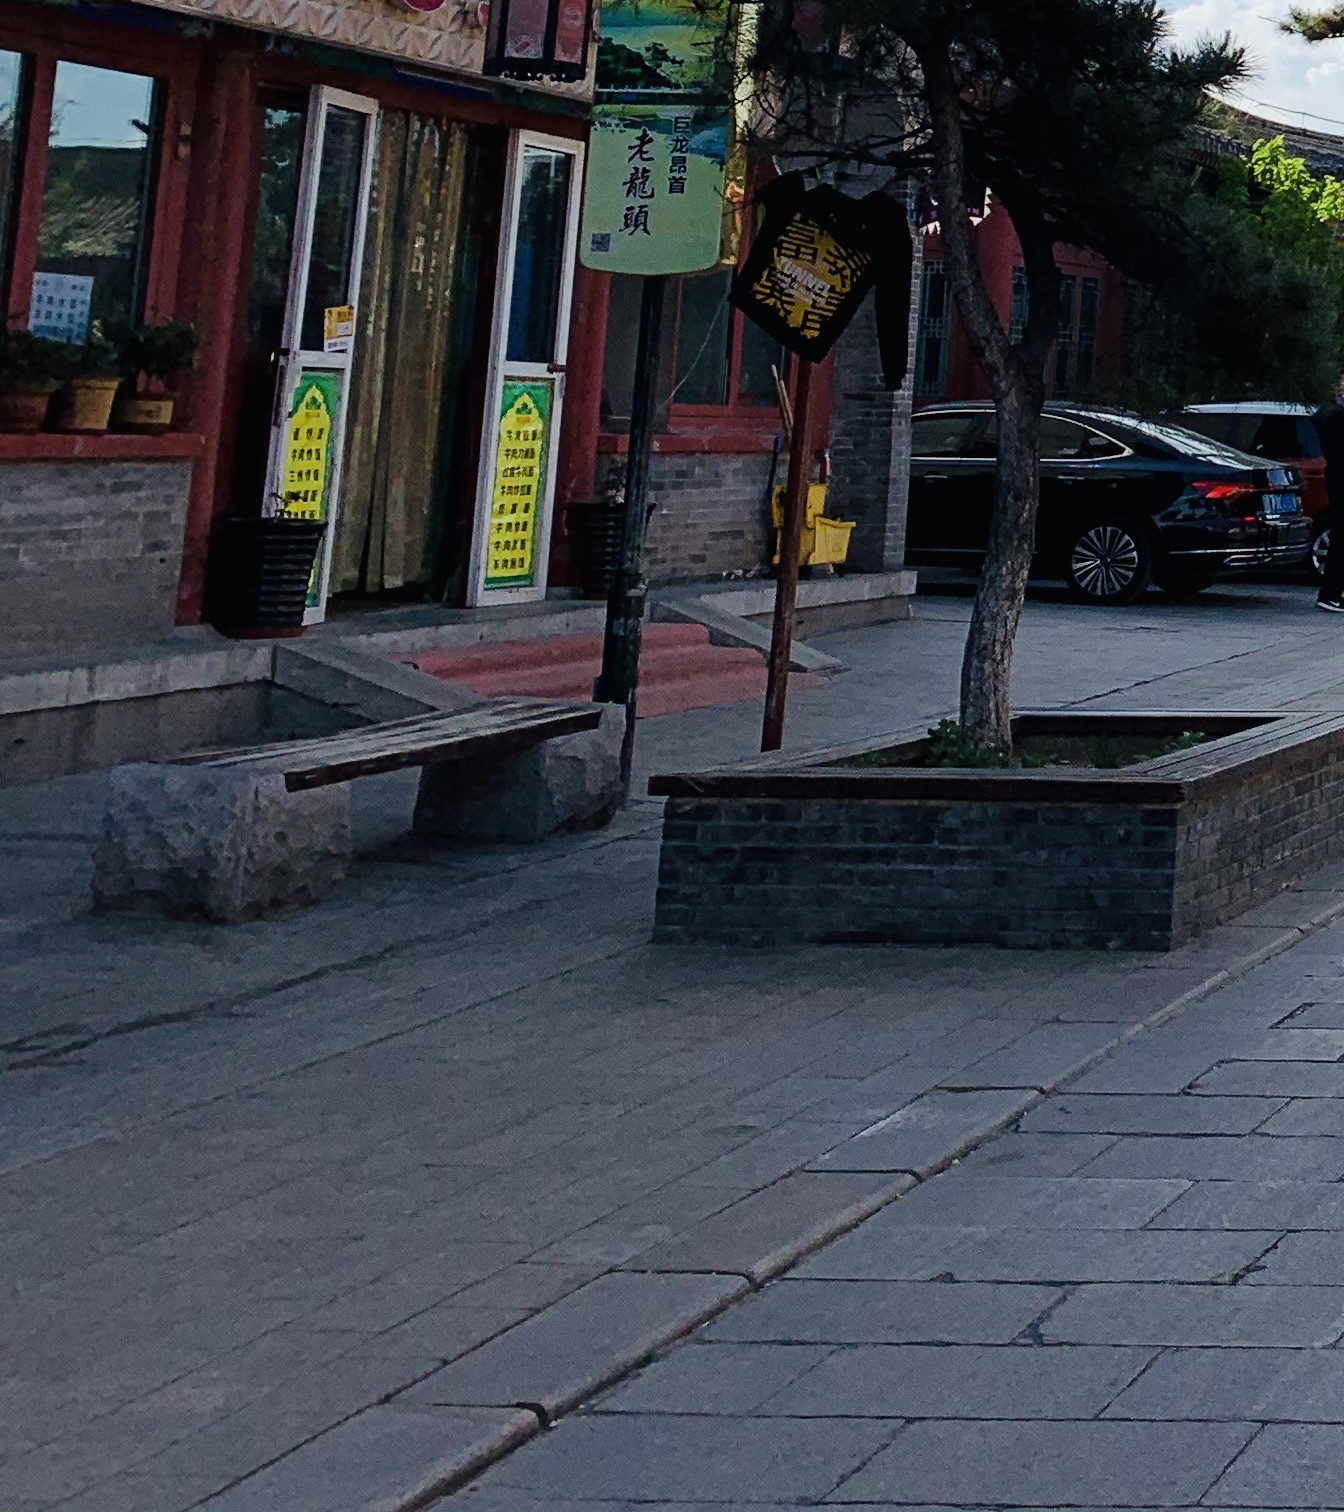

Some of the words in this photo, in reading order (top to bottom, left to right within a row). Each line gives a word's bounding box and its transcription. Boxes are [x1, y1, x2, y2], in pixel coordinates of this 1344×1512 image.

[617, 128, 656, 237] 老龍頭
[667, 116, 691, 195] 巨龙昂首
